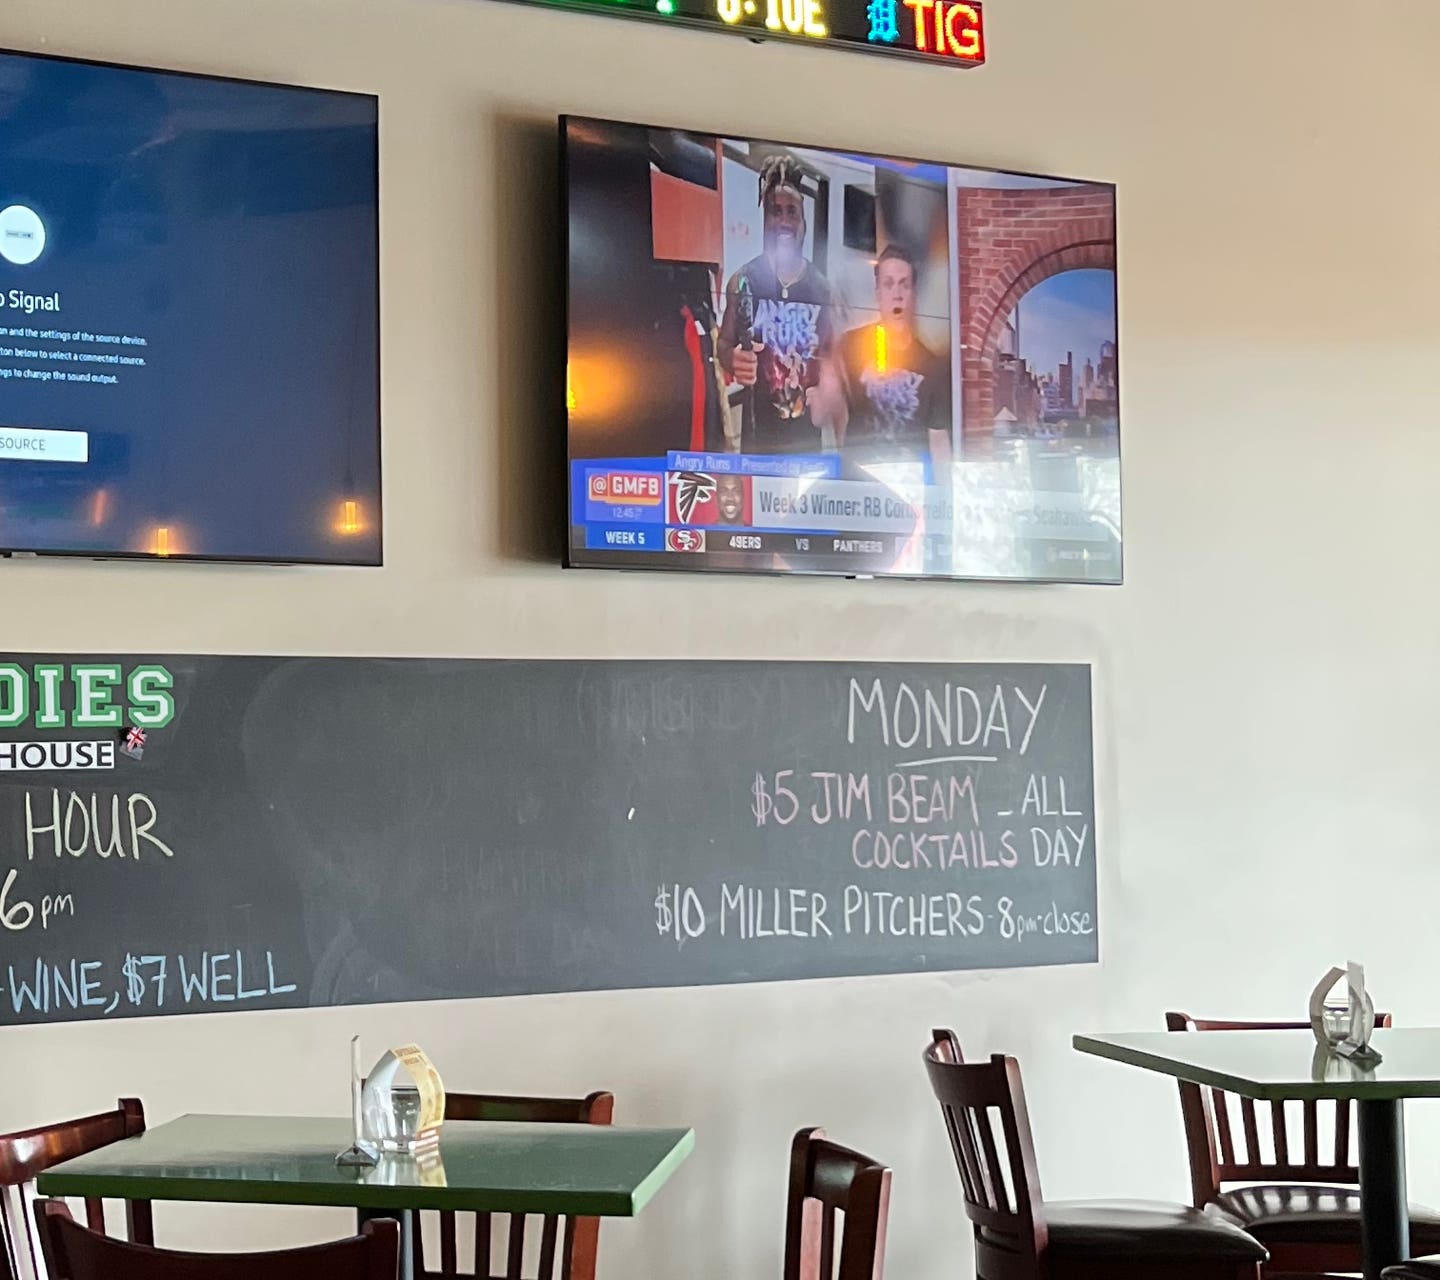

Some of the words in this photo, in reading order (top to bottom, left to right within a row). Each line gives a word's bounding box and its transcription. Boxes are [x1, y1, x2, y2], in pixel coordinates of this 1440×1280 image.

[9, 289, 60, 314] Signal
[9, 328, 24, 337] and
[25, 328, 38, 338] the
[40, 329, 71, 342] settings
[72, 331, 80, 340] of
[81, 332, 94, 342] the
[96, 334, 120, 344] source
[14, 348, 38, 358] below
[39, 350, 48, 359] to
[49, 351, 72, 360] select
[13, 368, 22, 378] to
[23, 369, 51, 381] change
[53, 370, 66, 380] the
[675, 454, 703, 472] Angry
[759, 491, 796, 513] Week
[800, 496, 808, 513] 3
[811, 496, 860, 517] Winner:
[864, 497, 881, 517] RB
[606, 531, 636, 545] WEEK
[729, 536, 761, 549] 49ERS
[795, 538, 809, 550] VS
[833, 539, 883, 553] PANTHERS
[846, 677, 1048, 755] MONDAY
[751, 769, 799, 827] $5
[811, 771, 872, 825] JIM
[887, 771, 980, 826] BEAM
[1021, 773, 1083, 817] ALL
[25, 787, 174, 860] HOUR
[851, 829, 1019, 872] COCKTAILS
[1030, 823, 1088, 868] DAY
[654, 882, 706, 942] $10
[720, 883, 833, 939] MILLER
[122, 952, 167, 1006] $7
[179, 951, 297, 1002] WELL
